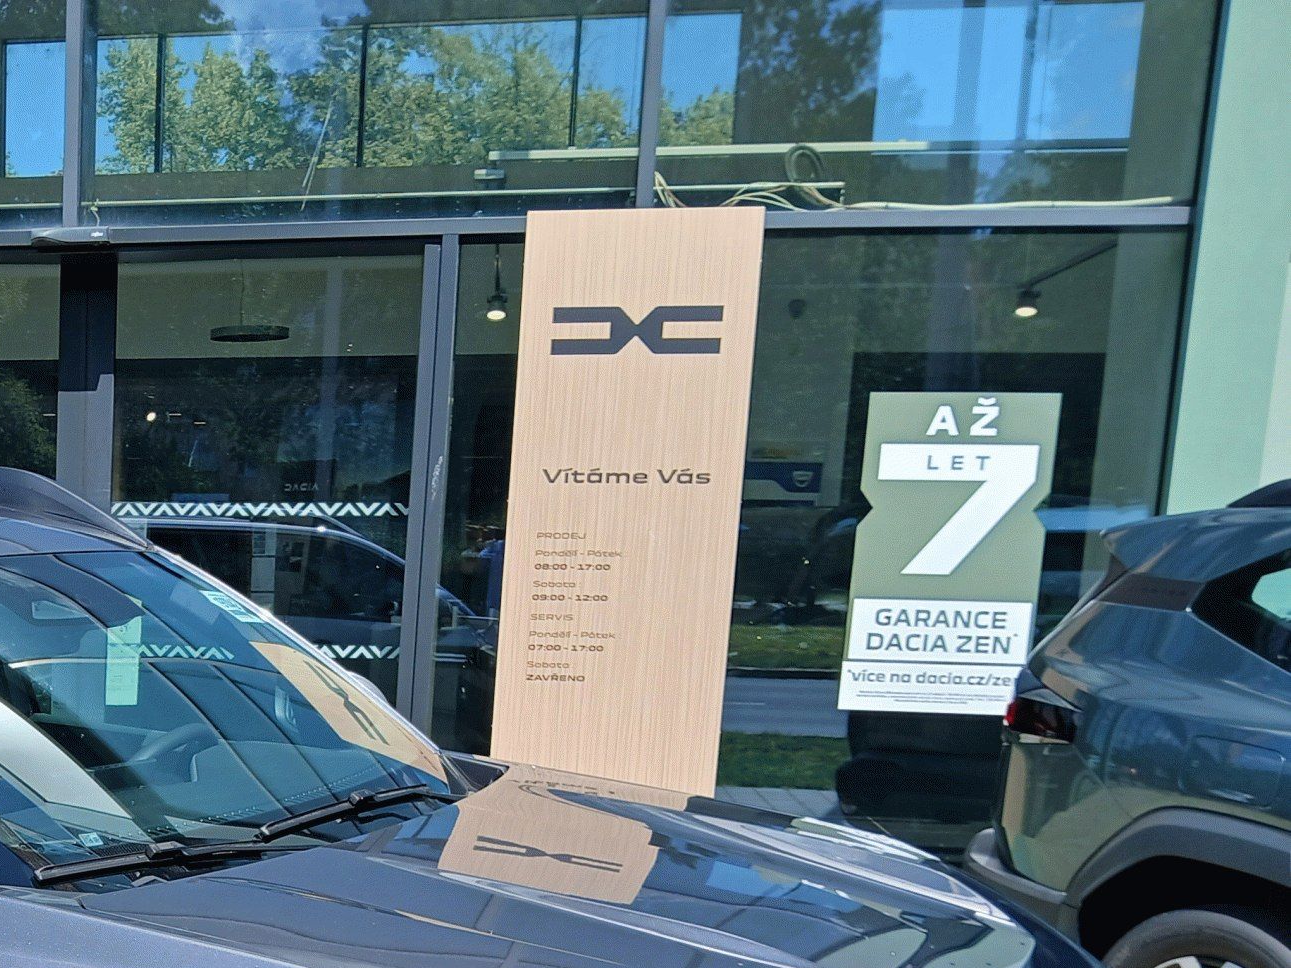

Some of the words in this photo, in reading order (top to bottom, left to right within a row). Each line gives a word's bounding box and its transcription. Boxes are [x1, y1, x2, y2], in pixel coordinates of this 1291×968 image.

[926, 396, 1002, 436] AŽ
[927, 455, 991, 471] LET
[542, 466, 648, 484] Vítáme
[657, 467, 711, 485] Vás
[878, 443, 1041, 575] 7
[536, 532, 587, 540] PRODEJ
[534, 563, 568, 571] 08:00
[577, 563, 611, 571] 17:00
[575, 594, 609, 602] 12:00
[530, 613, 574, 621] SERVIS
[875, 608, 1007, 629] GARANCE
[527, 644, 562, 652] 07:00
[866, 632, 947, 652] DACIA
[525, 673, 586, 682] ZAVŘENO
[890, 673, 911, 683] na
[916, 671, 1017, 687] dacia.cz/ze
